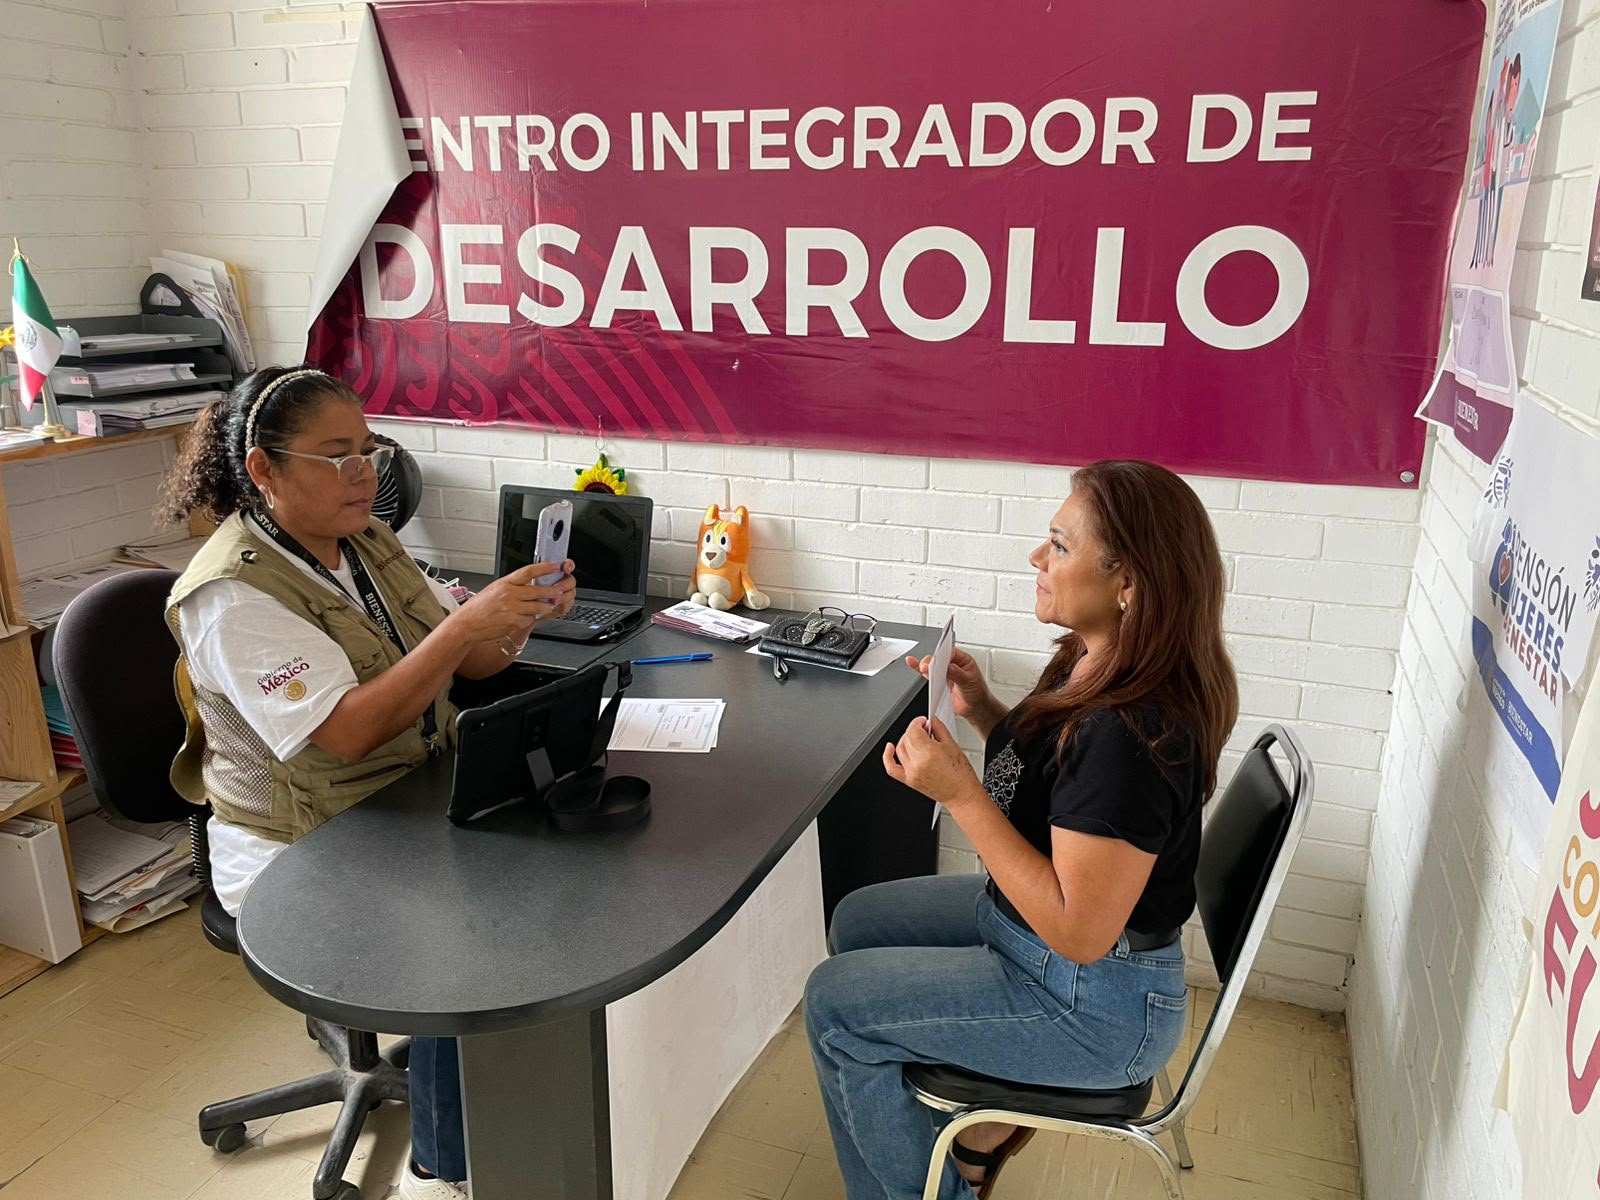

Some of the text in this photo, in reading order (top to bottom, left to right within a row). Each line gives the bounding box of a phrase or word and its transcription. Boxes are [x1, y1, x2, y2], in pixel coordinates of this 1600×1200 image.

[400, 90, 1318, 173] ENTRO INTEGRADOR DE
[359, 223, 1310, 351] DESARROLLO
[257, 661, 292, 686] Gobierno
[260, 662, 310, 696] México
